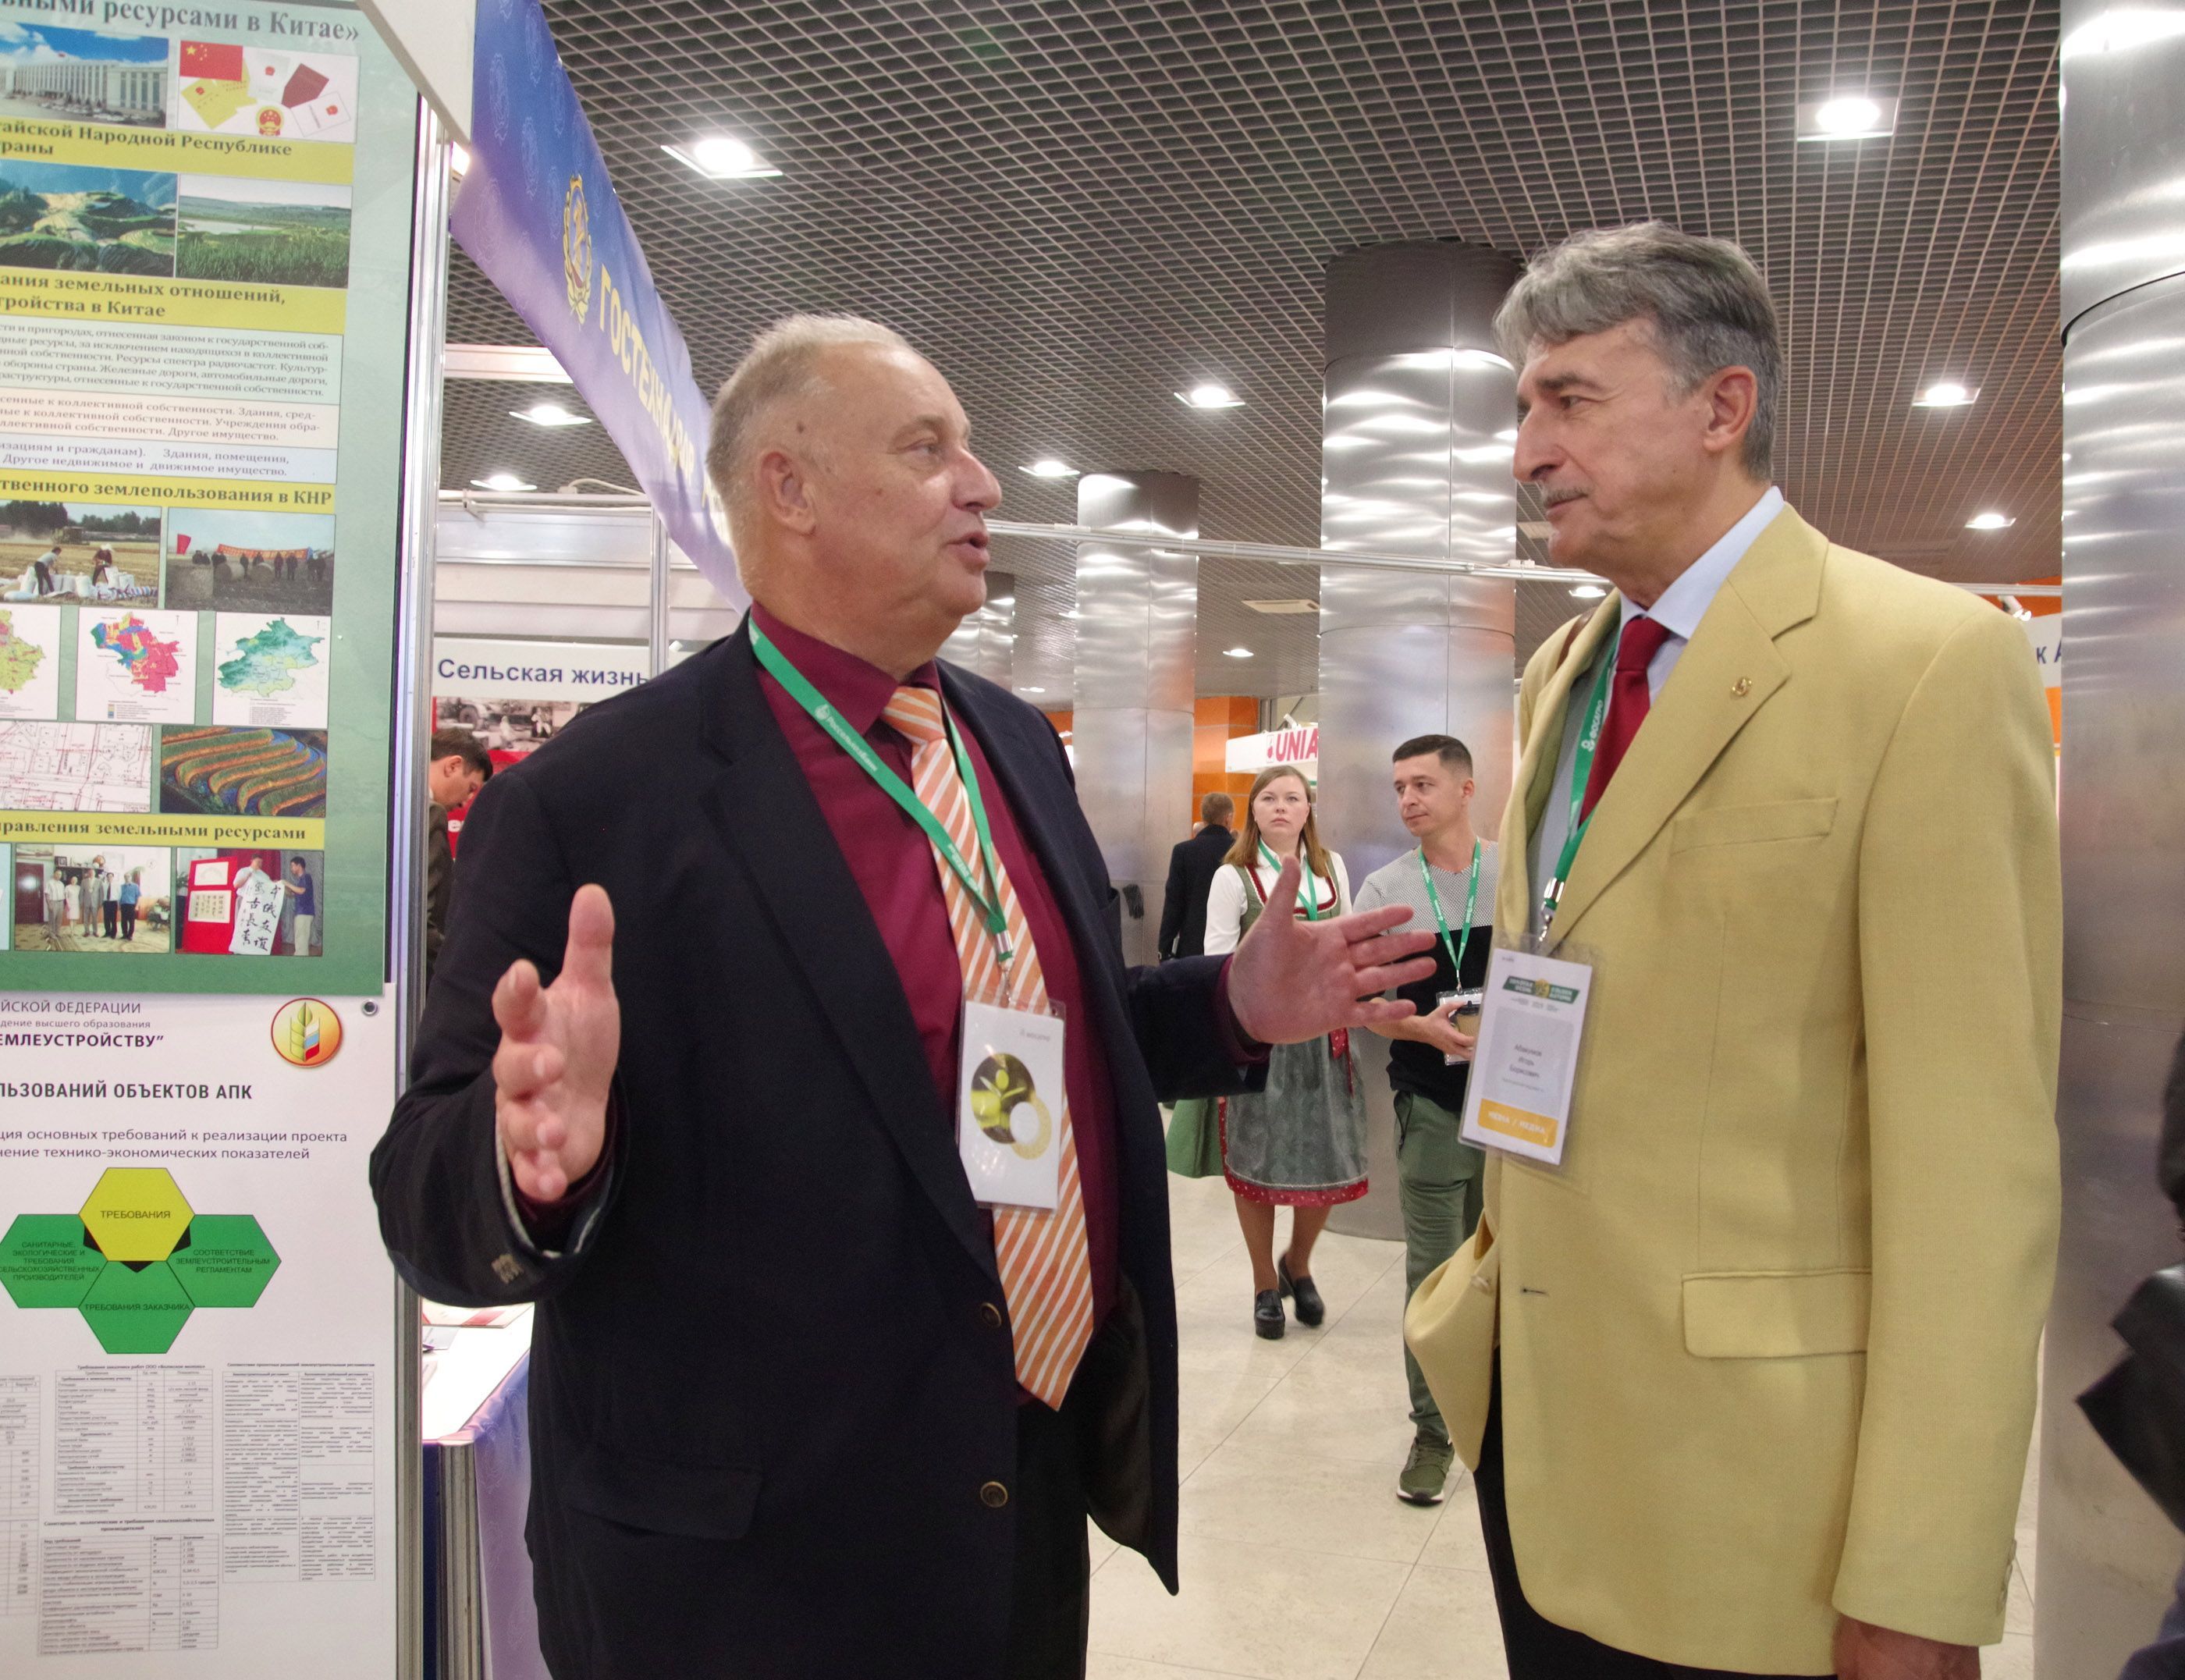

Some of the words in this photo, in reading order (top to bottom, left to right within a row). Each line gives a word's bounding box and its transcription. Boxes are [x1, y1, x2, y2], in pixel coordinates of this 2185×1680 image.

[2, 0, 94, 14] ыми
[103, 2, 237, 28] ресурсами
[270, 12, 359, 39] Китае»
[0, 121, 72, 137] айской
[80, 121, 175, 145] Народной
[182, 136, 291, 155] Республике
[0, 275, 49, 288] ания
[55, 279, 163, 294] земельных
[169, 287, 284, 304] отношений,
[108, 301, 165, 316] Китае
[599, 265, 695, 487] ГОСТЕХНАДЗОР
[0, 396, 44, 405] сенные
[94, 485, 272, 501] землепользования
[293, 490, 332, 505] КНР
[438, 659, 562, 681] Сельская
[572, 669, 649, 687] жизнь
[1275, 729, 1319, 762] UNIA
[0, 822, 90, 835] равления
[95, 824, 208, 836] земельными
[213, 827, 305, 841] ресурсами
[0, 998, 51, 1012] ЙСКОЙ
[55, 999, 140, 1014] ФЕДЕРАЦИИ
[0, 1019, 32, 1028] дение
[82, 1018, 151, 1029] образования
[114, 1084, 208, 1098] ОБЪЕКТОВ
[215, 1084, 252, 1099] АПК
[26, 1131, 98, 1139] основных
[101, 1128, 187, 1142] требований
[202, 1131, 287, 1142] реализации
[291, 1132, 347, 1143] проекта
[43, 1149, 217, 1158] технико-экономических
[221, 1148, 310, 1159] показателей
[99, 1209, 171, 1219] ТРЕБОВАНИЯ
[83, 1302, 141, 1311] ТРЕБОВАНИЯ
[142, 1302, 193, 1311] ЗАКАЗЧИКА
